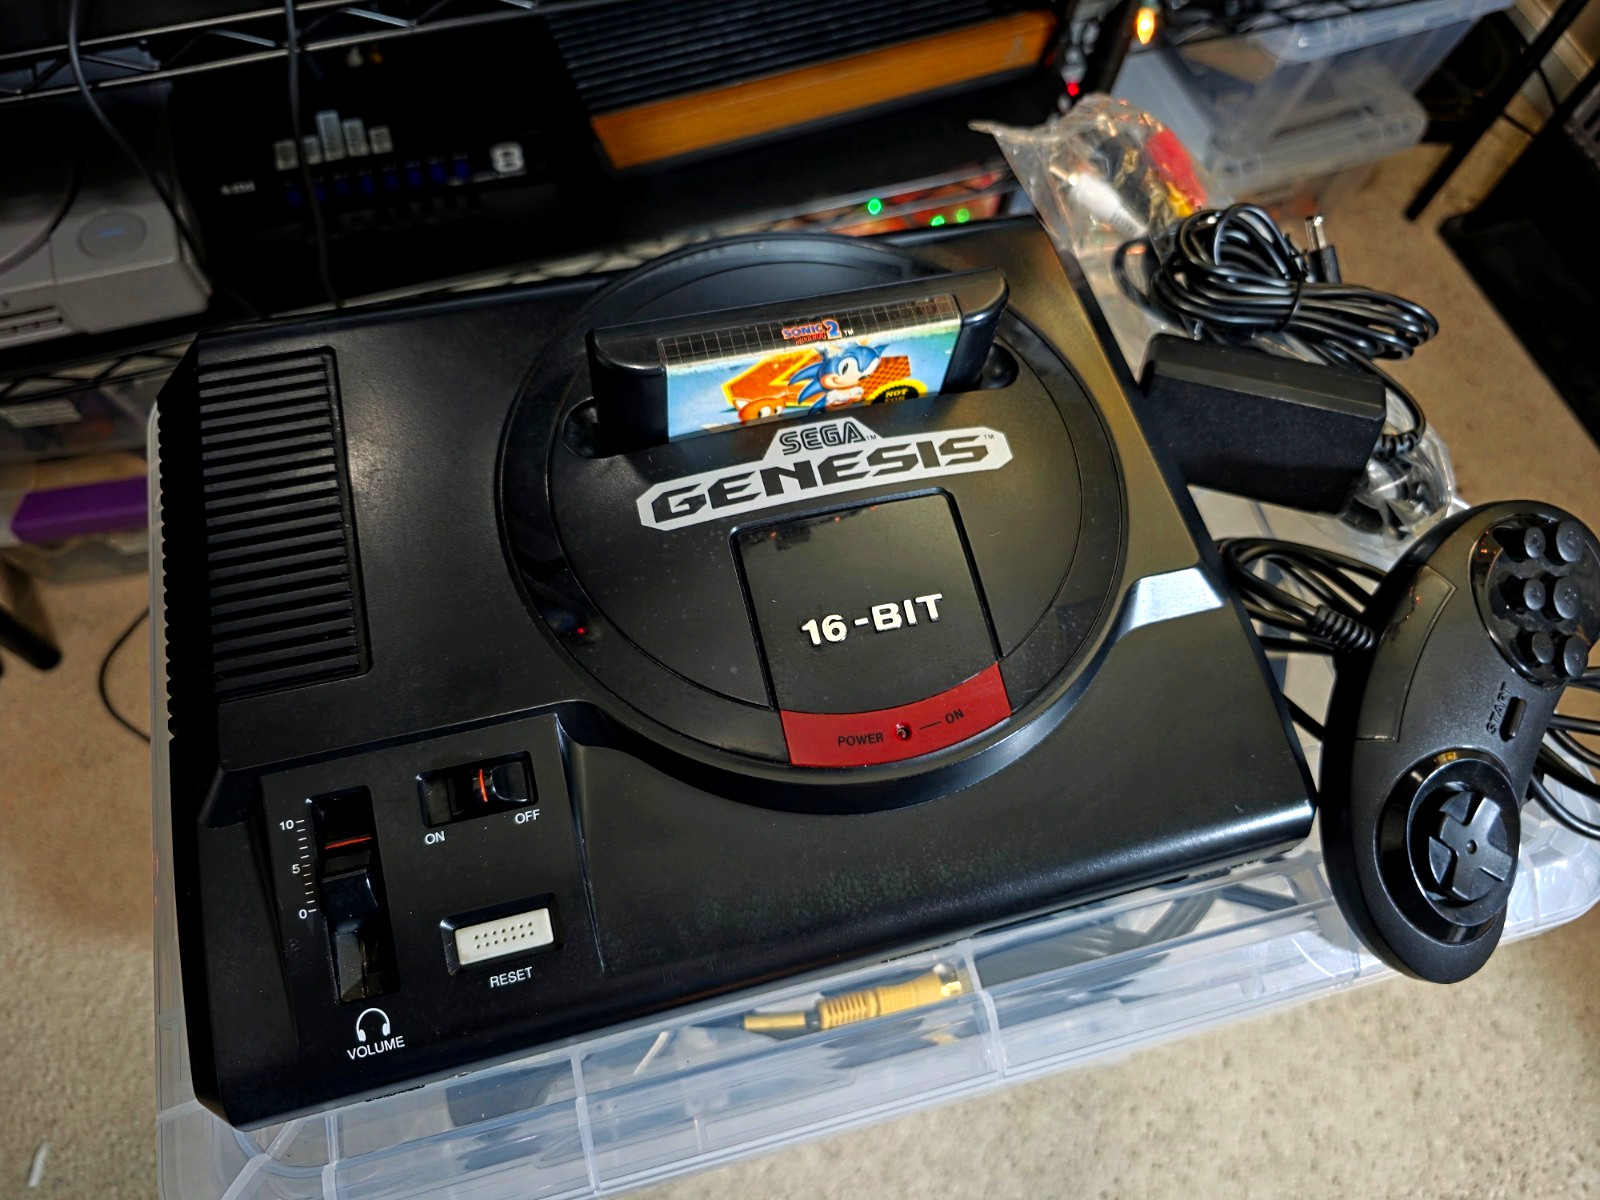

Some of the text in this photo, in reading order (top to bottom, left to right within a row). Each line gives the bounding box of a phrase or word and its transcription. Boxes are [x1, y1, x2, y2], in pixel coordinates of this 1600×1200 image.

[782, 322, 825, 340] SONIC
[822, 318, 842, 340] 2
[885, 387, 908, 398] NOT
[780, 421, 867, 456] SEGA
[651, 435, 989, 523] GENESIS
[801, 593, 943, 647] 16-BIT
[1486, 681, 1512, 735] START
[837, 708, 965, 747] POWER ON
[279, 819, 295, 831] 10
[514, 808, 540, 825] OFF
[424, 830, 446, 845] ON
[292, 863, 301, 874] 5
[298, 908, 308, 919] 0
[489, 966, 533, 988] RESET
[347, 1035, 406, 1060] VOLUME
